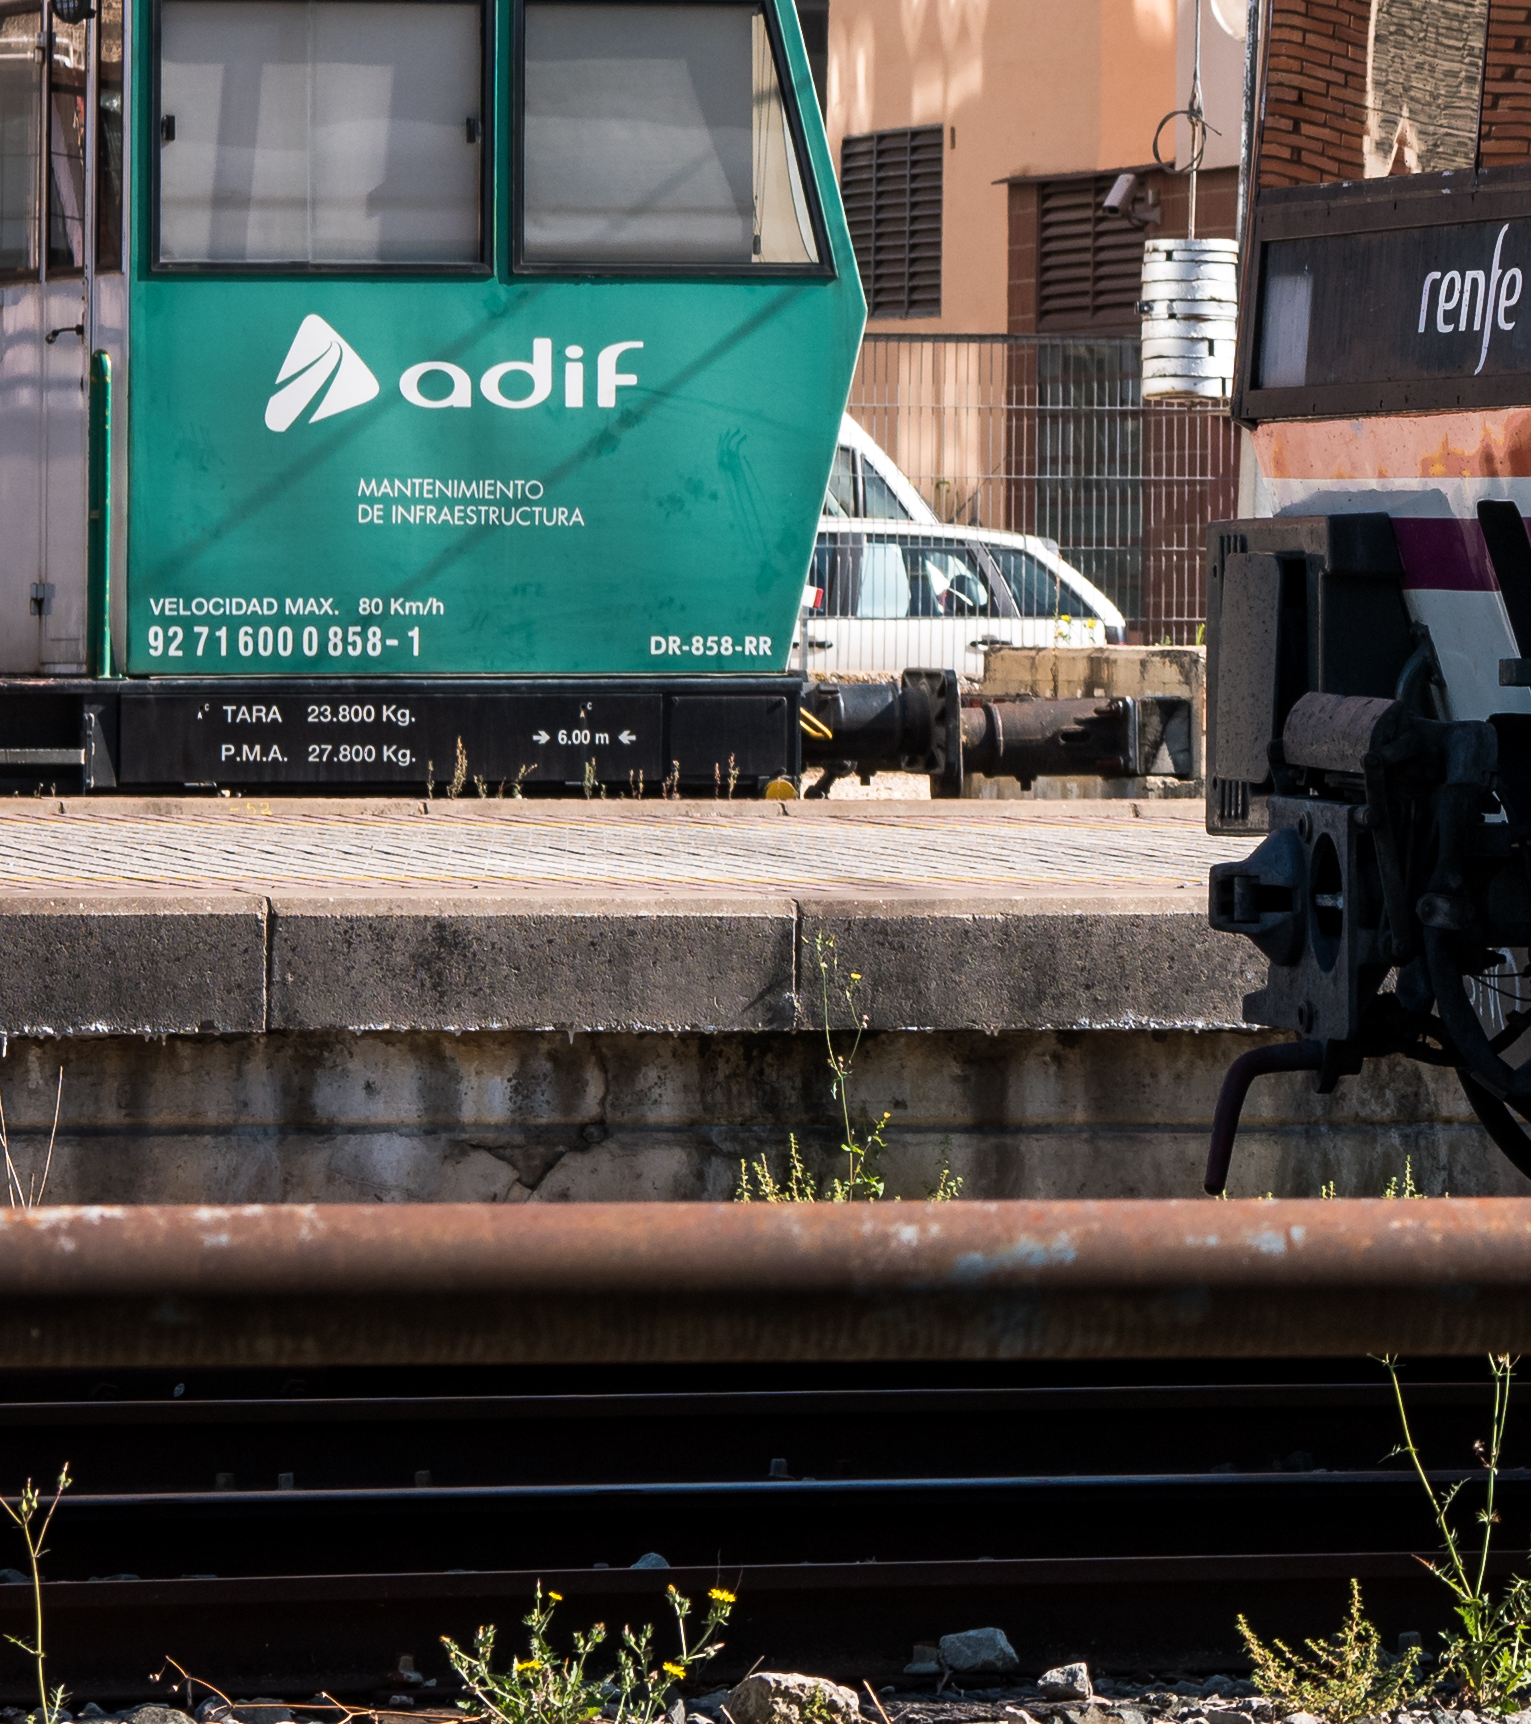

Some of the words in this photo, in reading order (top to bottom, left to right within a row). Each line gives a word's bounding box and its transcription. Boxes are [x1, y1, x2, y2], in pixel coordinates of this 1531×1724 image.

[1418, 223, 1523, 375] renfe
[399, 338, 644, 409] adif
[357, 478, 544, 500] MANTENIMIENTO
[358, 504, 384, 524] DE
[392, 505, 585, 526] INFRAESTRUCTURA
[150, 597, 278, 615] VELOCIDAD
[285, 598, 339, 615] MAX.
[358, 597, 383, 615] 80
[390, 597, 444, 615] Km/h
[148, 626, 183, 656] 92
[193, 626, 227, 656] 71
[238, 626, 293, 656] 600
[650, 636, 772, 656] DR-858-RR
[222, 705, 282, 723] TARA
[307, 705, 375, 722] 23.800
[382, 705, 416, 726] Kg.
[558, 730, 590, 745] 6.00
[595, 732, 610, 744] m
[221, 744, 288, 762] P.M.A.
[308, 745, 375, 762] 27.800
[383, 745, 416, 766] Kg.
